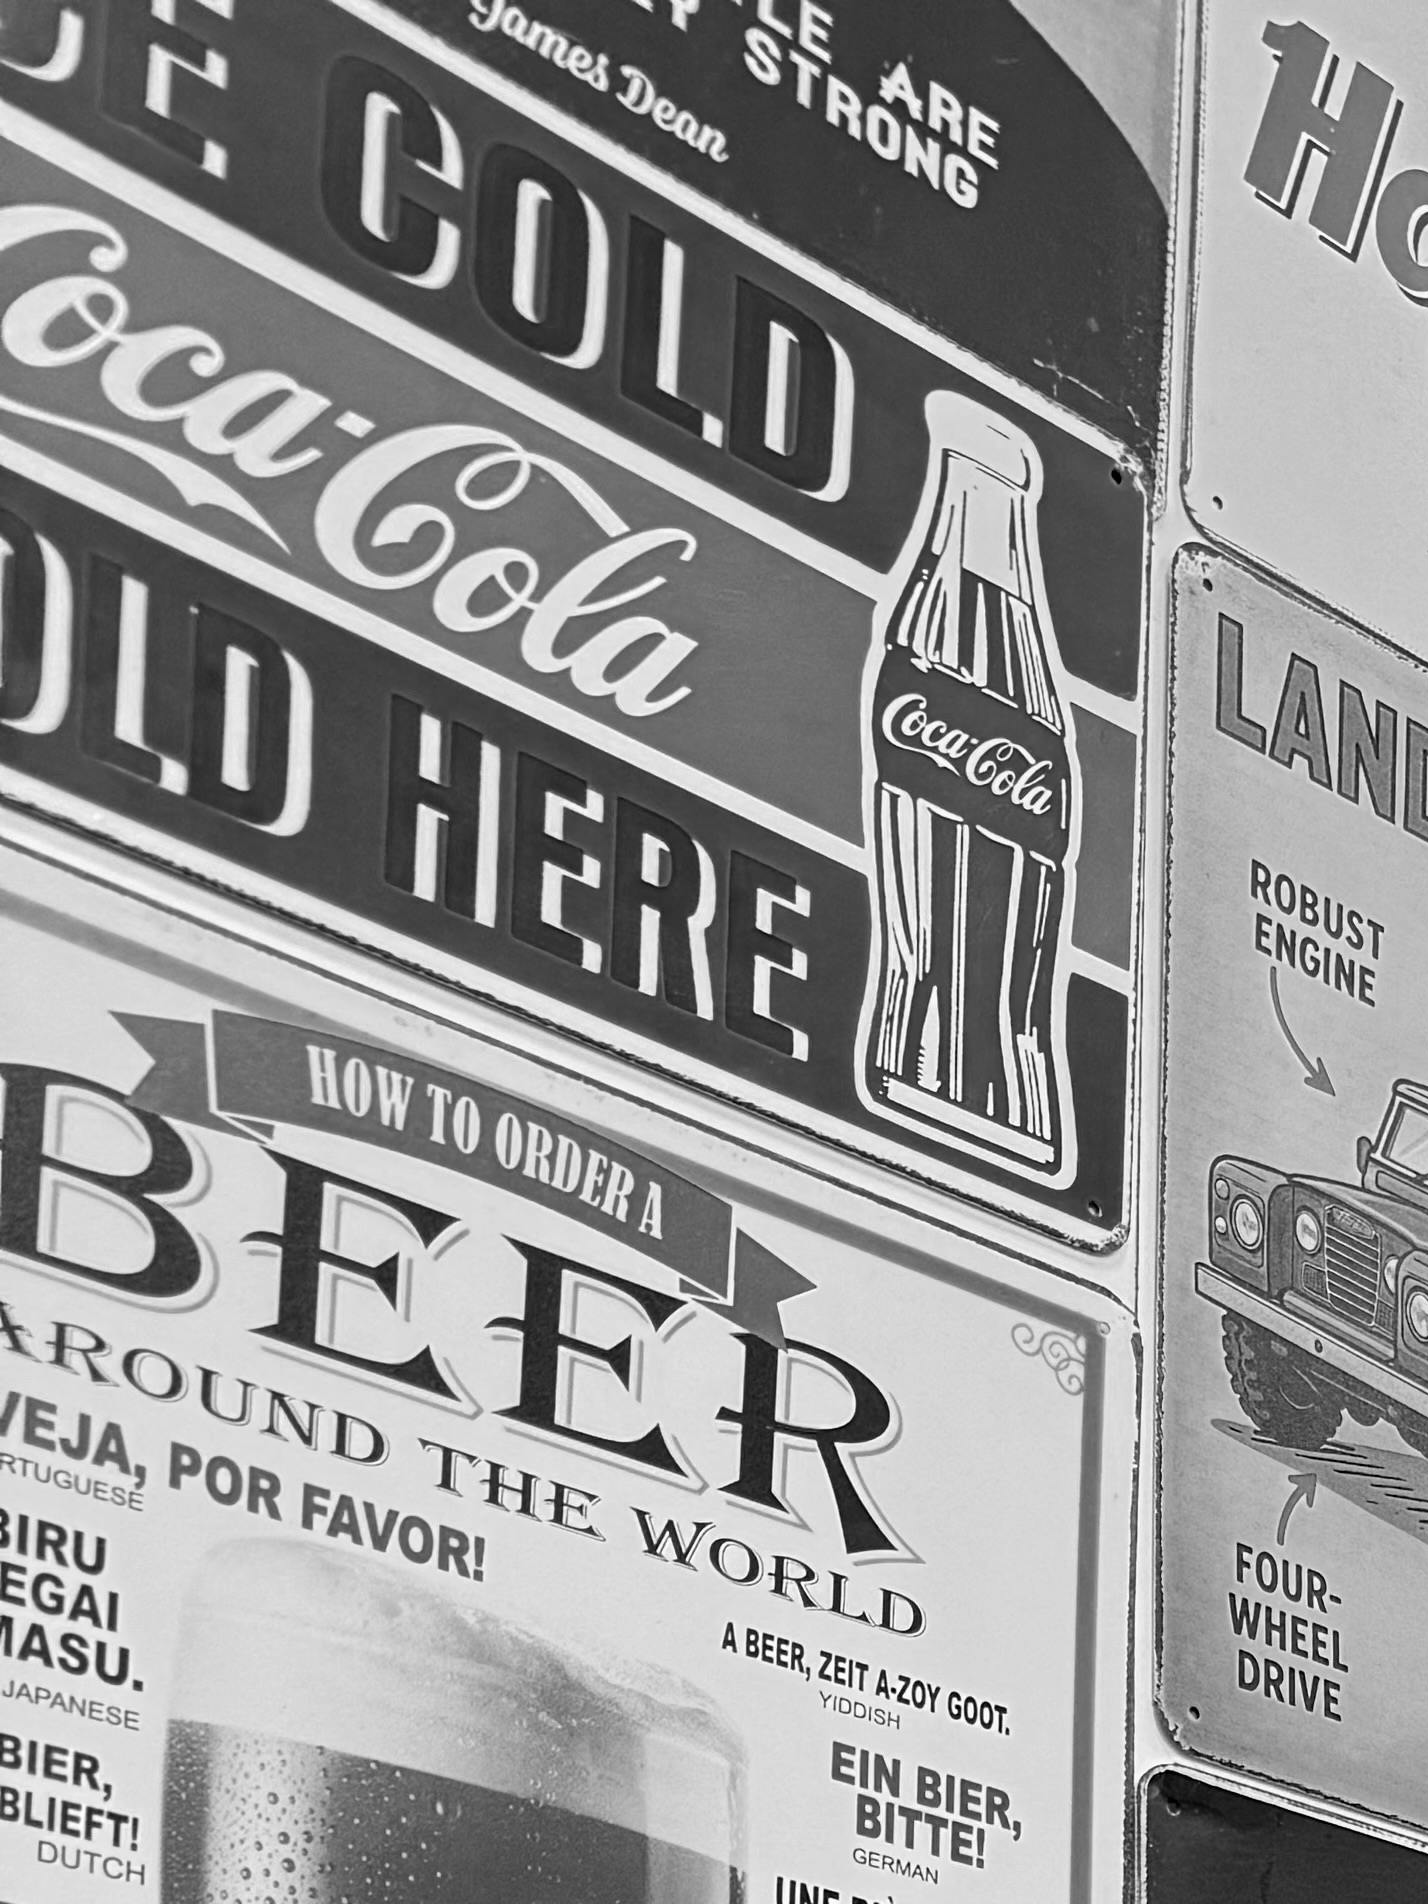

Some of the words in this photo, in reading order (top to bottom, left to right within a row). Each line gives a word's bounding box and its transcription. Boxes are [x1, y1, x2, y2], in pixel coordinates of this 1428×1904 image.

[619, 67, 729, 164] Dean
[743, 47, 980, 208] STRONG
[879, 61, 999, 169] ARE
[321, 52, 855, 502] COLD
[881, 692, 1052, 817] Coca-Cola
[384, 692, 810, 1062] HERE
[1251, 858, 1385, 962] ROBUST
[1253, 914, 1378, 1009] ENGINE
[307, 1044, 412, 1133] HOW
[427, 1080, 478, 1155] TO
[492, 1112, 639, 1225] ORDER
[637, 1176, 664, 1241] A
[0, 1061, 926, 1567] BEER
[169, 1442, 282, 1520] POR
[301, 1482, 486, 1581] FAVOR!
[417, 1436, 603, 1539] THE
[632, 1505, 927, 1639] WORLD
[1234, 1541, 1343, 1608] FOUR-
[1229, 1591, 1349, 1675] WHEEL
[1, 1678, 141, 1731] JAPANESE
[1238, 1648, 1343, 1724] DRIVE
[830, 1741, 901, 1798] EIN
[916, 1764, 1023, 1841] BIER,
[855, 1794, 986, 1869] BITTE!
[38, 1841, 146, 1886] DUTCH
